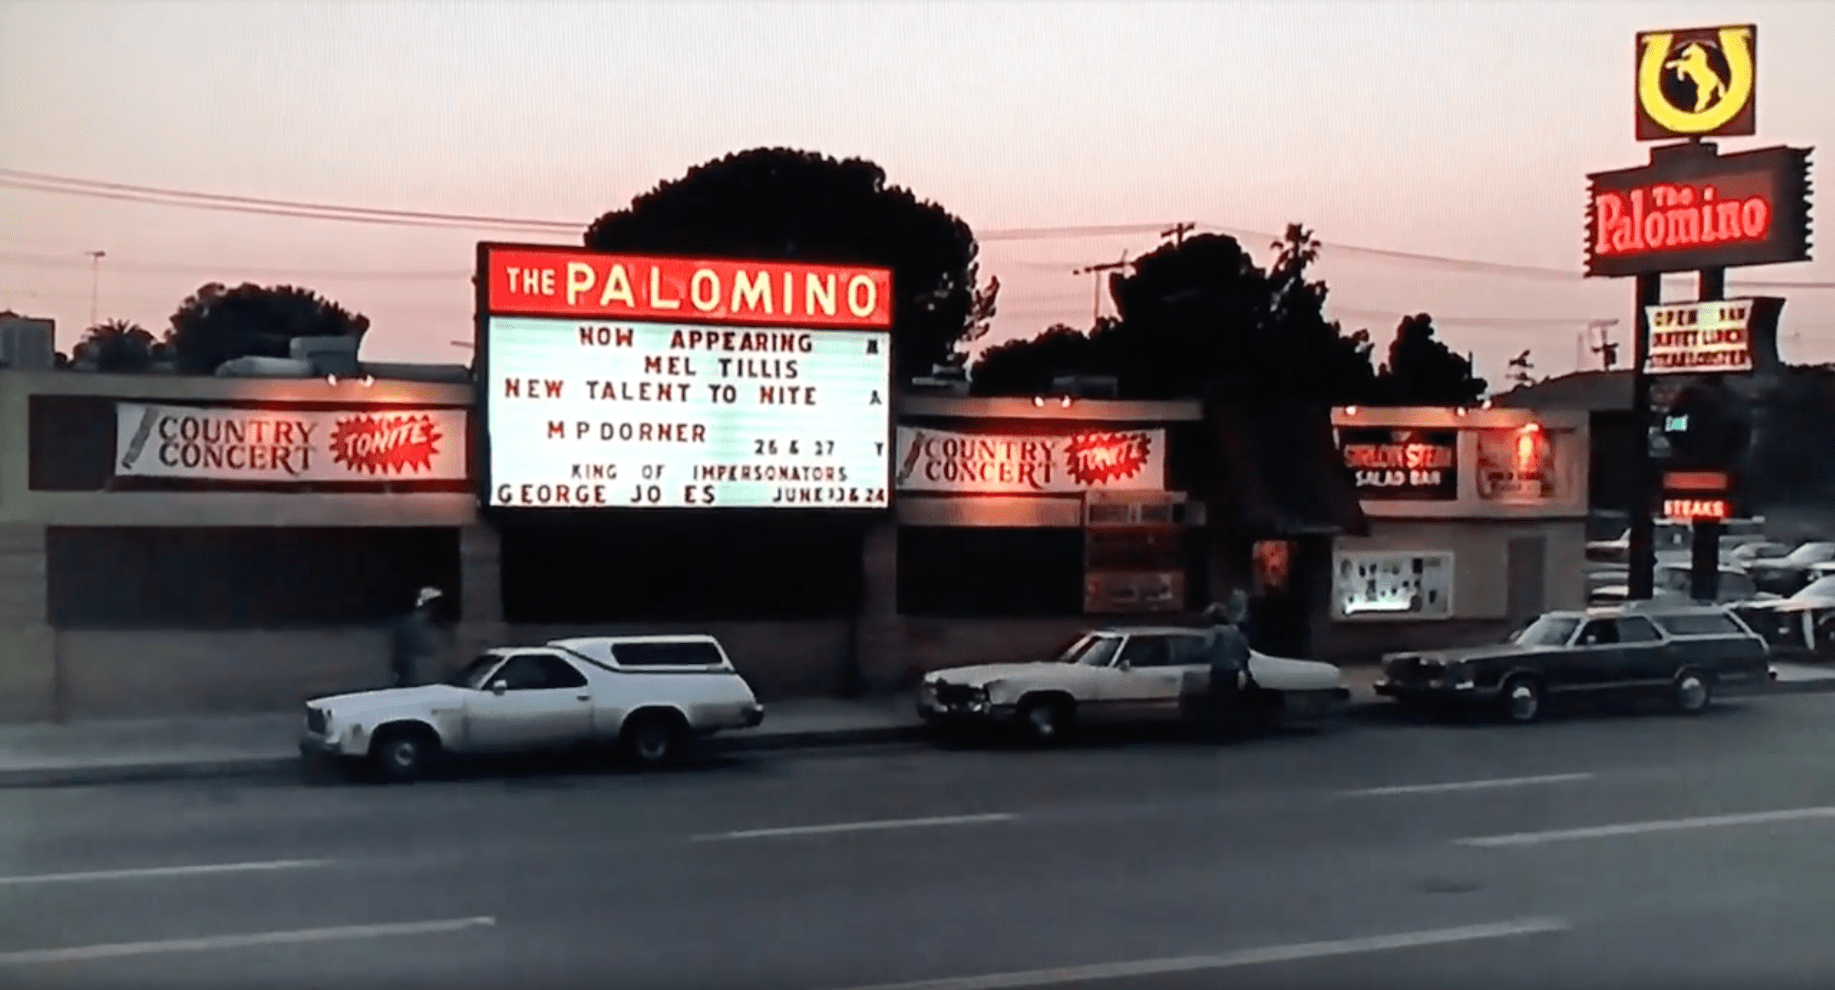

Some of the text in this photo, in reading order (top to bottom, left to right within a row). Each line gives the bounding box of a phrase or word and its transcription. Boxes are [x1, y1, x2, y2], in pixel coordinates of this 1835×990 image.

[1653, 185, 1693, 206] The
[1595, 187, 1767, 255] Palomino
[507, 262, 877, 317] THE PALOMINO
[1655, 309, 1697, 326] OPEN
[579, 327, 814, 353] NOW APPEARING
[644, 356, 798, 379] MEL TILLIS
[505, 379, 816, 406] NEW TALENT TO NITE
[158, 416, 318, 444] COUNTRY
[344, 421, 429, 459] TONITE
[158, 443, 318, 476] CONCERT
[925, 438, 1055, 461] COUNTRY
[572, 464, 848, 481] KING OF IMPERSONATORS
[925, 461, 1053, 489] CONCERT
[1355, 469, 1441, 487] SALAD BAR
[497, 484, 606, 504] GEORGE
[772, 487, 821, 503] JUNE
[1663, 499, 1724, 517] STEAKS
